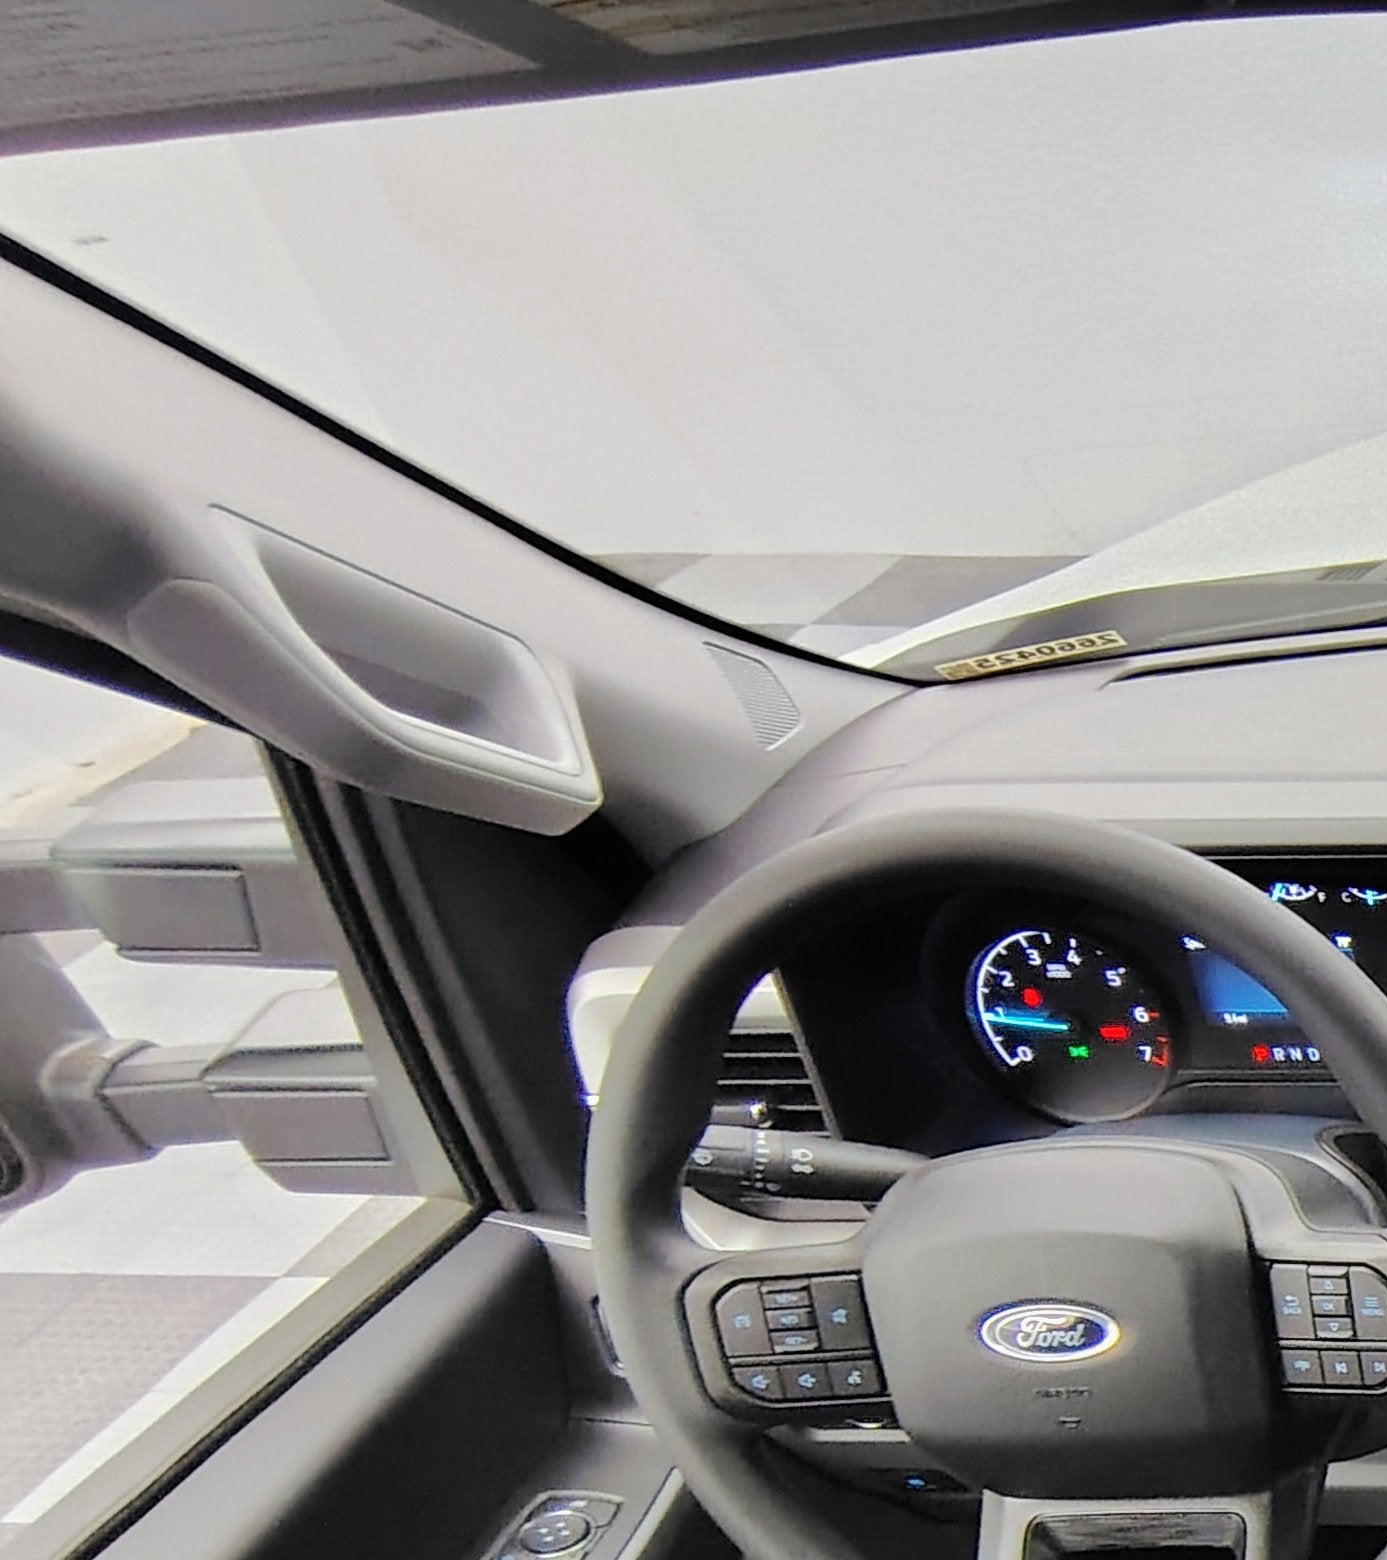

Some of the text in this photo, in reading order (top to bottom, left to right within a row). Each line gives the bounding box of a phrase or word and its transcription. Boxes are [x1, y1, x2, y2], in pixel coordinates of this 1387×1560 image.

[1026, 949, 1042, 966] 3
[1066, 949, 1082, 966] 4
[998, 971, 1015, 987] 2
[1105, 969, 1121, 987] 5
[1132, 1006, 1150, 1023] 6
[1016, 1045, 1032, 1062] 0
[1138, 1045, 1152, 1062] 7
[1272, 1047, 1285, 1061] R
[1287, 1047, 1302, 1061] N
[1306, 1047, 1320, 1062] D
[1016, 1316, 1086, 1348] Ford
